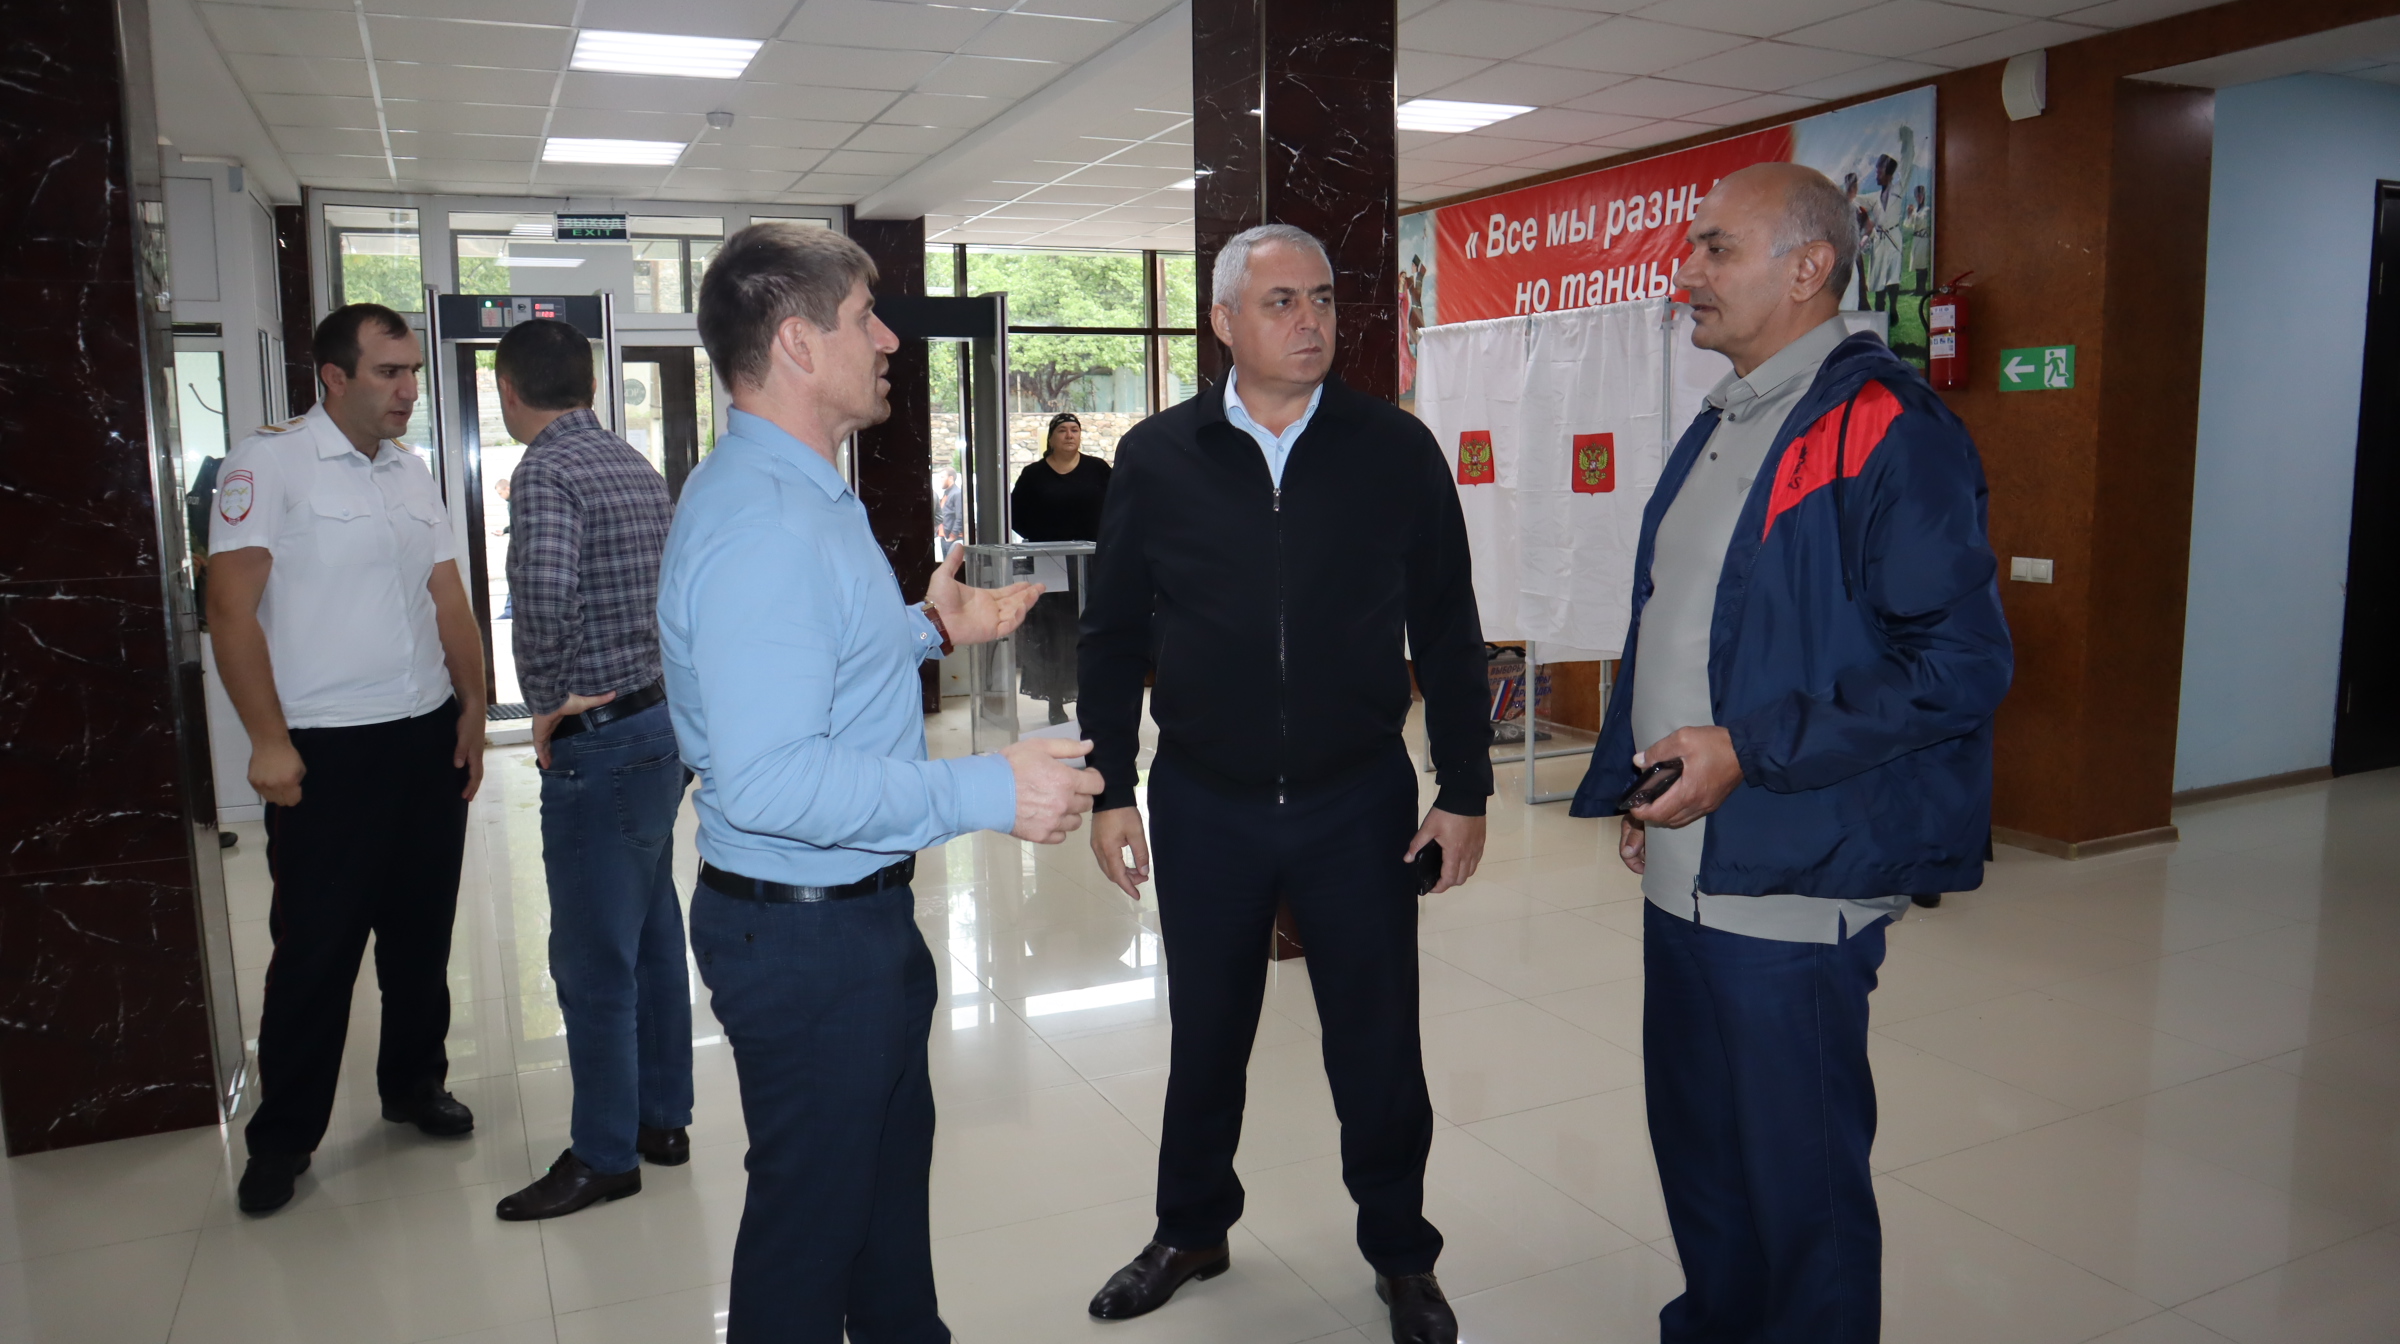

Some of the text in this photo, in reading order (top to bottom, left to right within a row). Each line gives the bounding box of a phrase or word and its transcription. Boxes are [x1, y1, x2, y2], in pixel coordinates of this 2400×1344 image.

[563, 217, 622, 229] ВЫХОД
[572, 228, 613, 236] EXIT
[1486, 213, 1538, 258] Все
[1546, 204, 1597, 248] мы
[1514, 277, 1550, 315] но
[1491, 664, 1524, 675] ВЫБОРЫ
